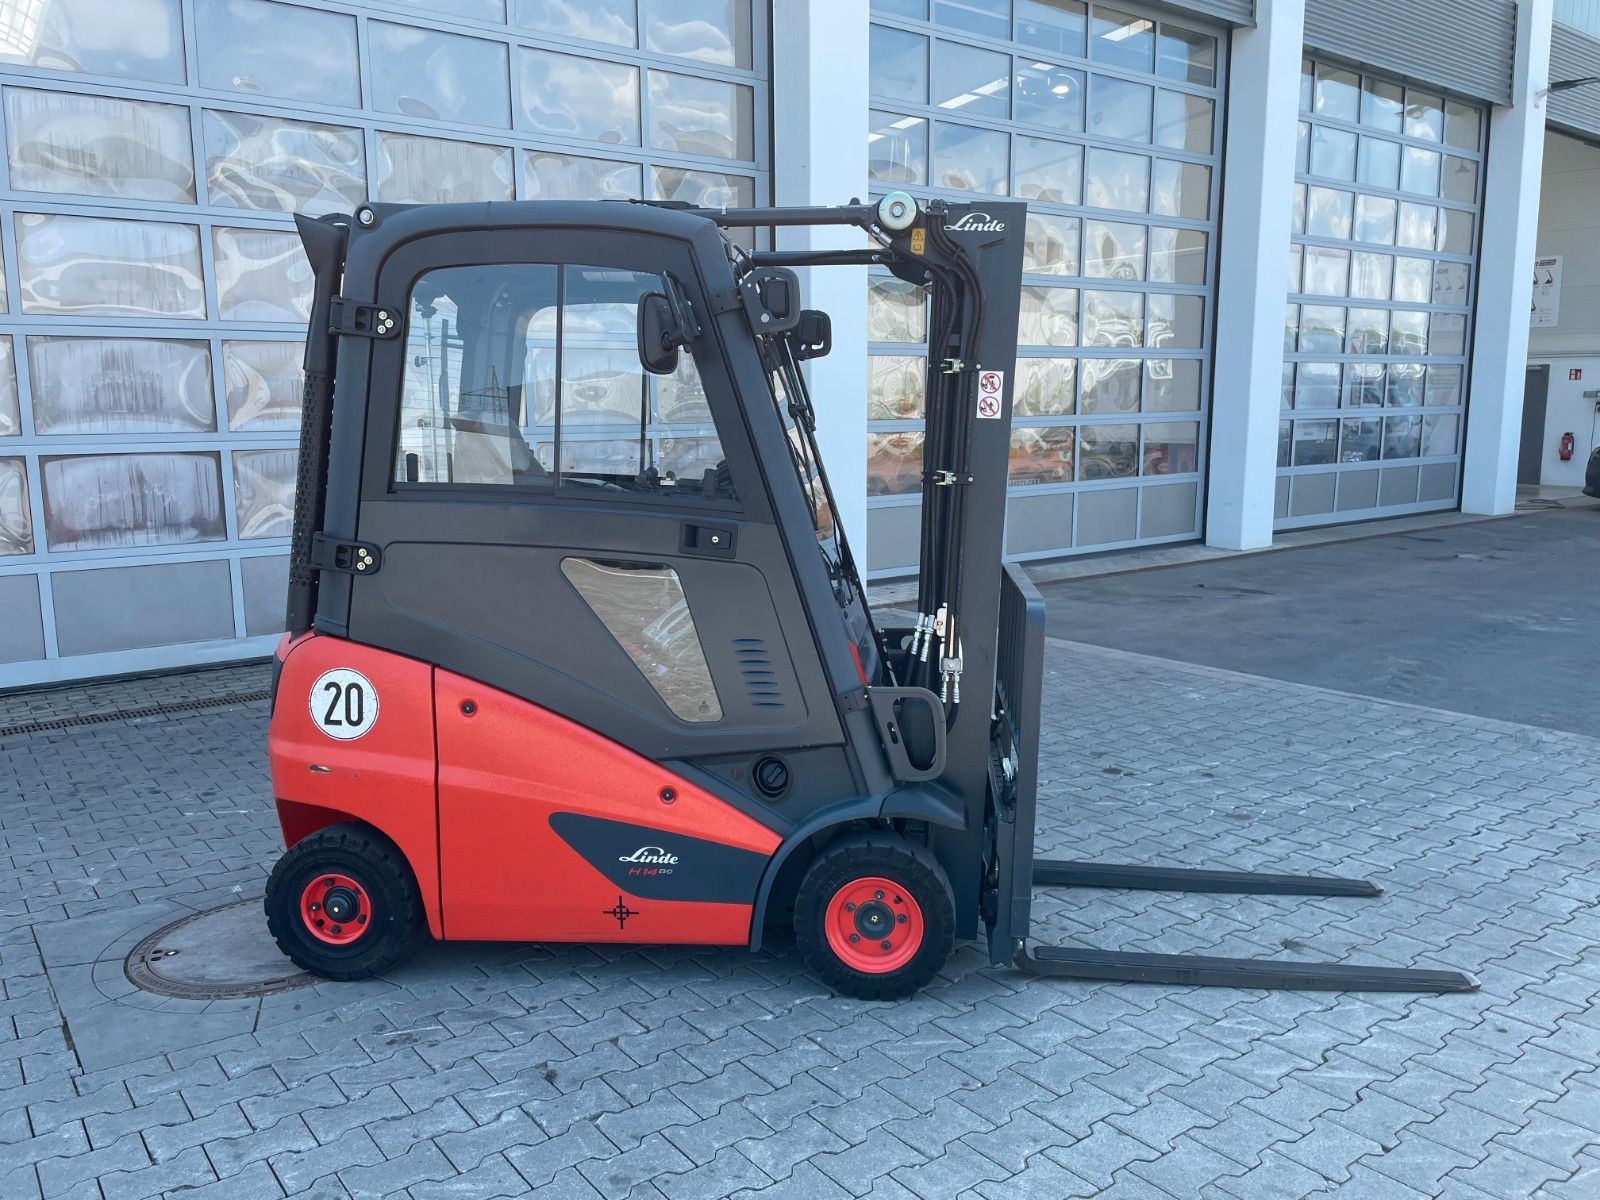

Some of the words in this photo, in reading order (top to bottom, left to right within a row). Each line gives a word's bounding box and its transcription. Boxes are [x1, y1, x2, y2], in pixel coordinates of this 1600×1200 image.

[943, 212, 1005, 232] Linde
[324, 681, 364, 727] 20
[618, 846, 679, 865] Linde
